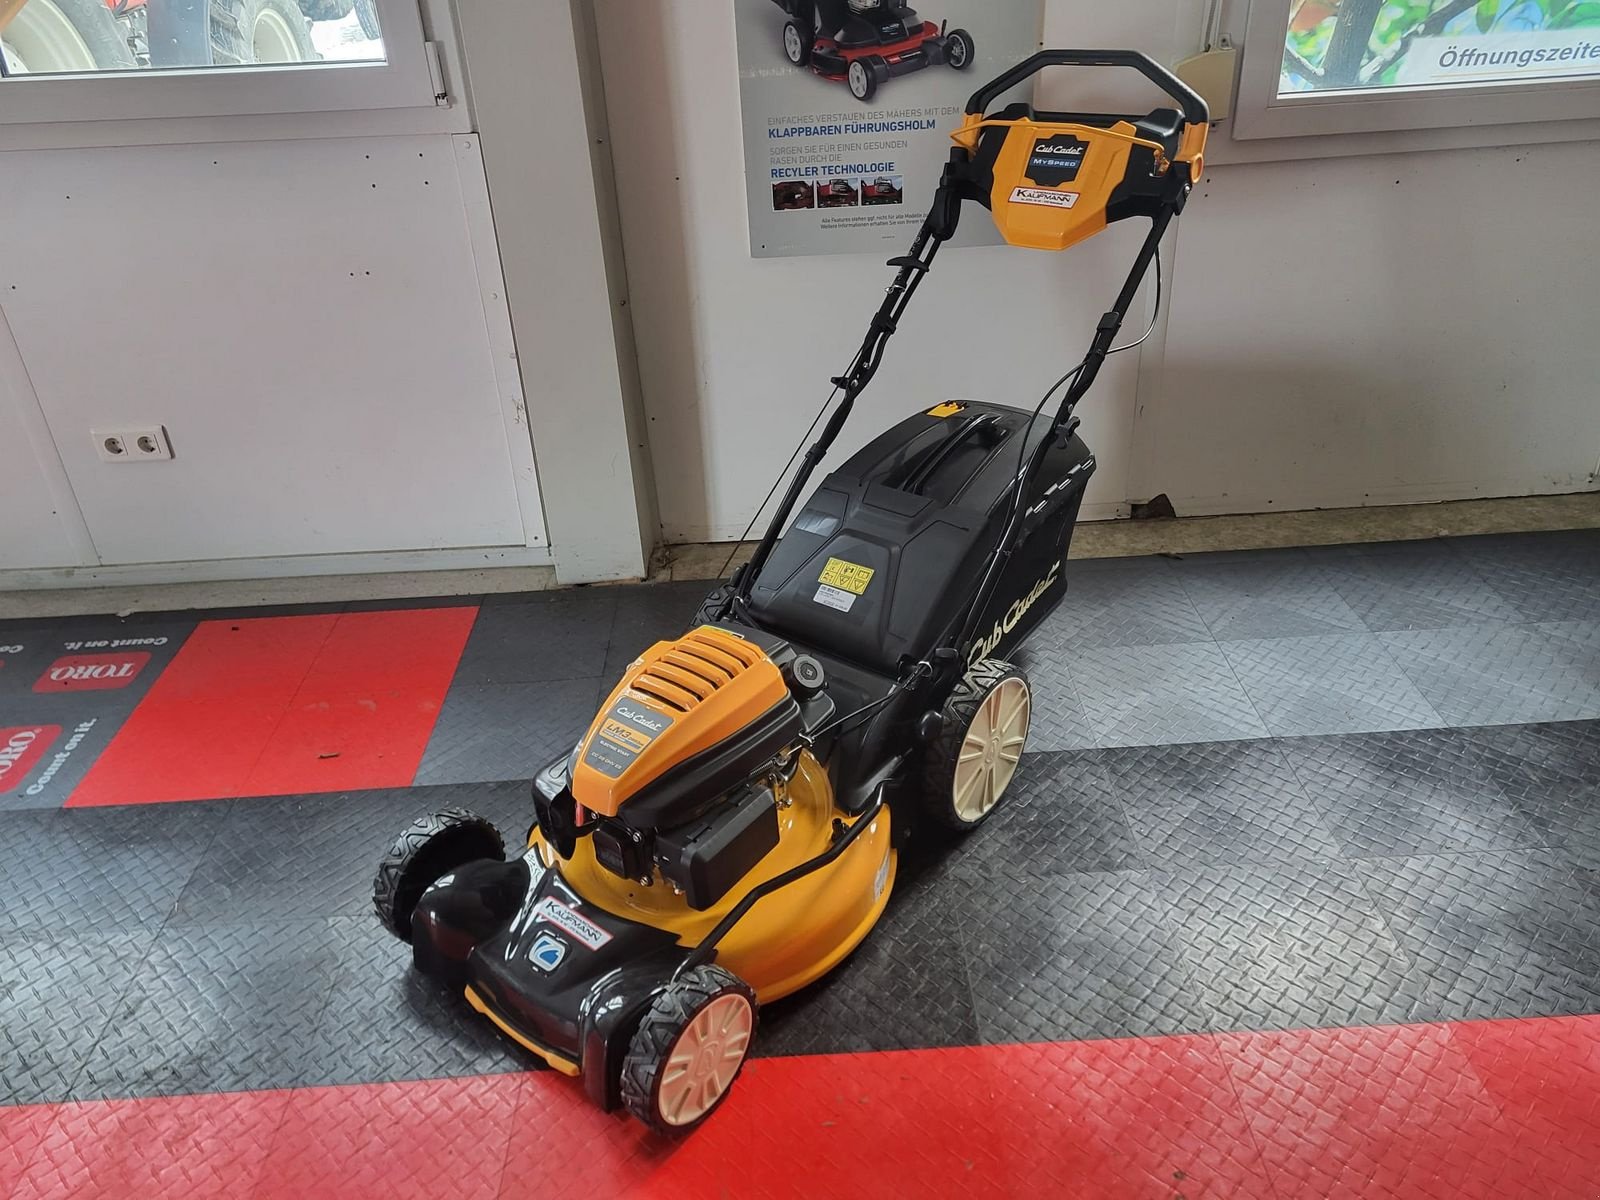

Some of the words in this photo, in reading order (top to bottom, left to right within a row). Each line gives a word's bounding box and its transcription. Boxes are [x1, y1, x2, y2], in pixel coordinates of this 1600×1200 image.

[768, 115, 814, 126] EINFACHES
[816, 112, 865, 123] VERSTAUEN
[867, 111, 884, 120] DES
[924, 107, 938, 117] MIT
[941, 106, 960, 115] DEM
[768, 125, 842, 139] KLAPPBAREN
[844, 119, 936, 134] FÜHRUNGSHOLM
[770, 146, 803, 156] SORGEN
[804, 145, 818, 155] SIE
[837, 142, 862, 152] EINEN
[863, 140, 908, 151] GESUNDEN
[1035, 144, 1054, 154] Cub
[1053, 145, 1084, 155] Cadet
[770, 156, 798, 166] RASEN
[800, 154, 827, 164] DURCH
[829, 153, 842, 162] DIE
[771, 166, 819, 179] RECYLER
[821, 162, 895, 177] TECHNOLOGIE
[1016, 189, 1071, 203] KAUFMANN
[1003, 560, 1061, 634] Cadet
[64, 641, 82, 650] it.
[85, 640, 109, 648] on
[111, 637, 168, 647] Count
[50, 662, 135, 681] TORO
[74, 718, 97, 733] it.
[616, 706, 636, 719] Cub
[633, 714, 662, 731] Cadet
[606, 723, 632, 738] LM3
[65, 733, 85, 751] on
[26, 752, 70, 795] Count
[545, 901, 600, 941] KAUFMANN
